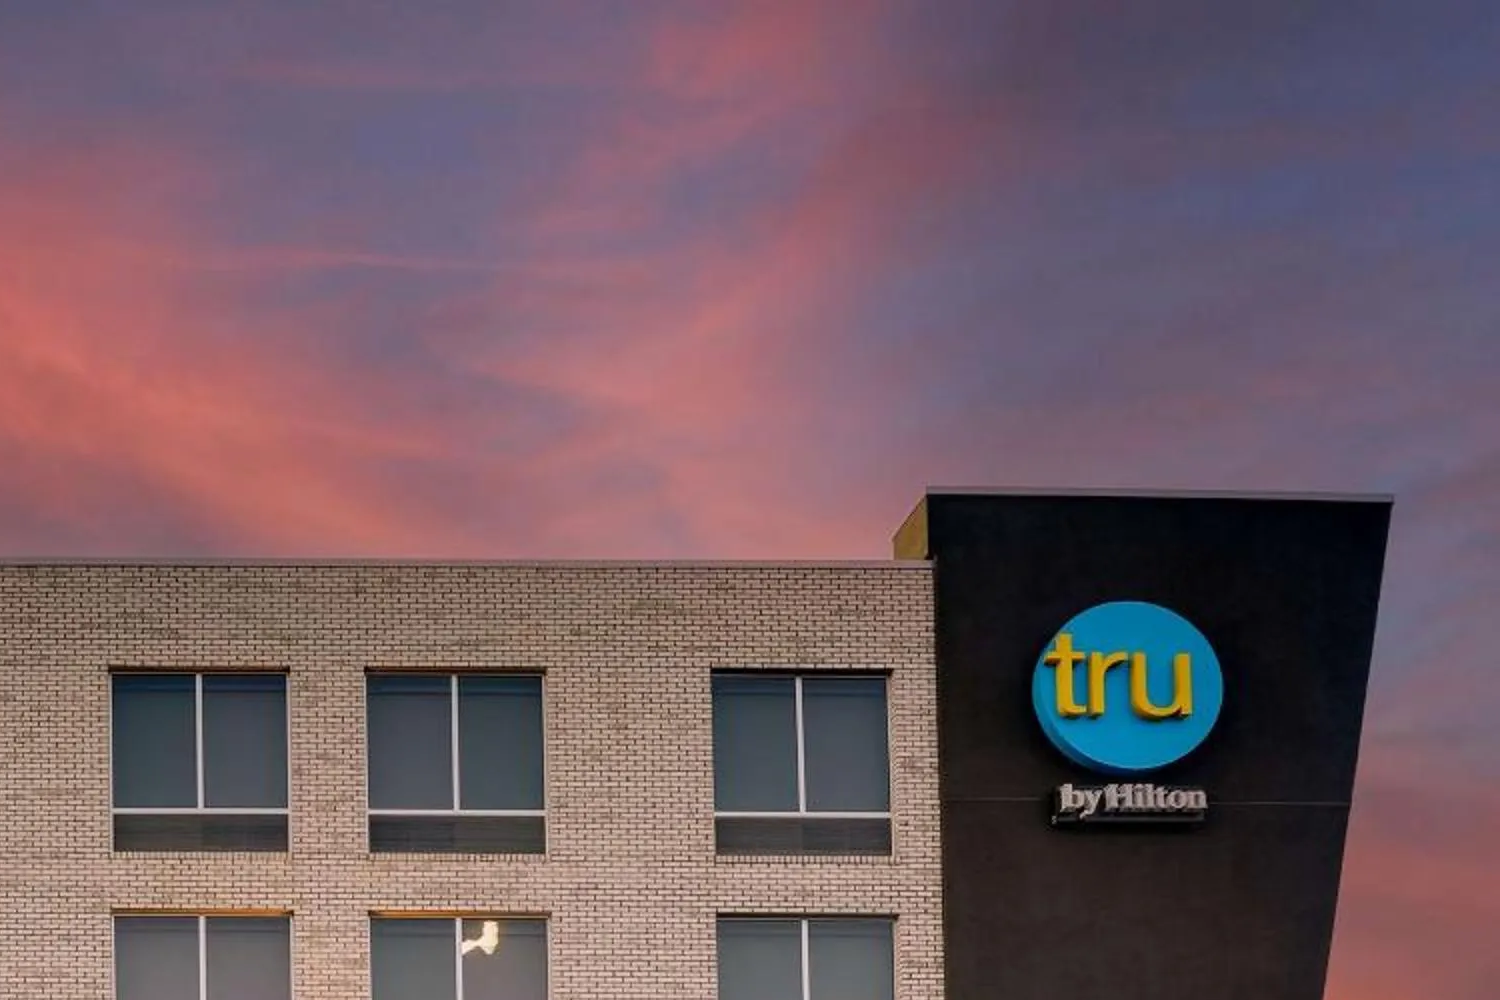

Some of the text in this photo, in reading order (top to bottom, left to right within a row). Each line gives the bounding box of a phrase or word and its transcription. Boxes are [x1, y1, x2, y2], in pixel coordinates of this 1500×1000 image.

[1043, 632, 1193, 719] tru
[1059, 783, 1208, 819] by Hilton
